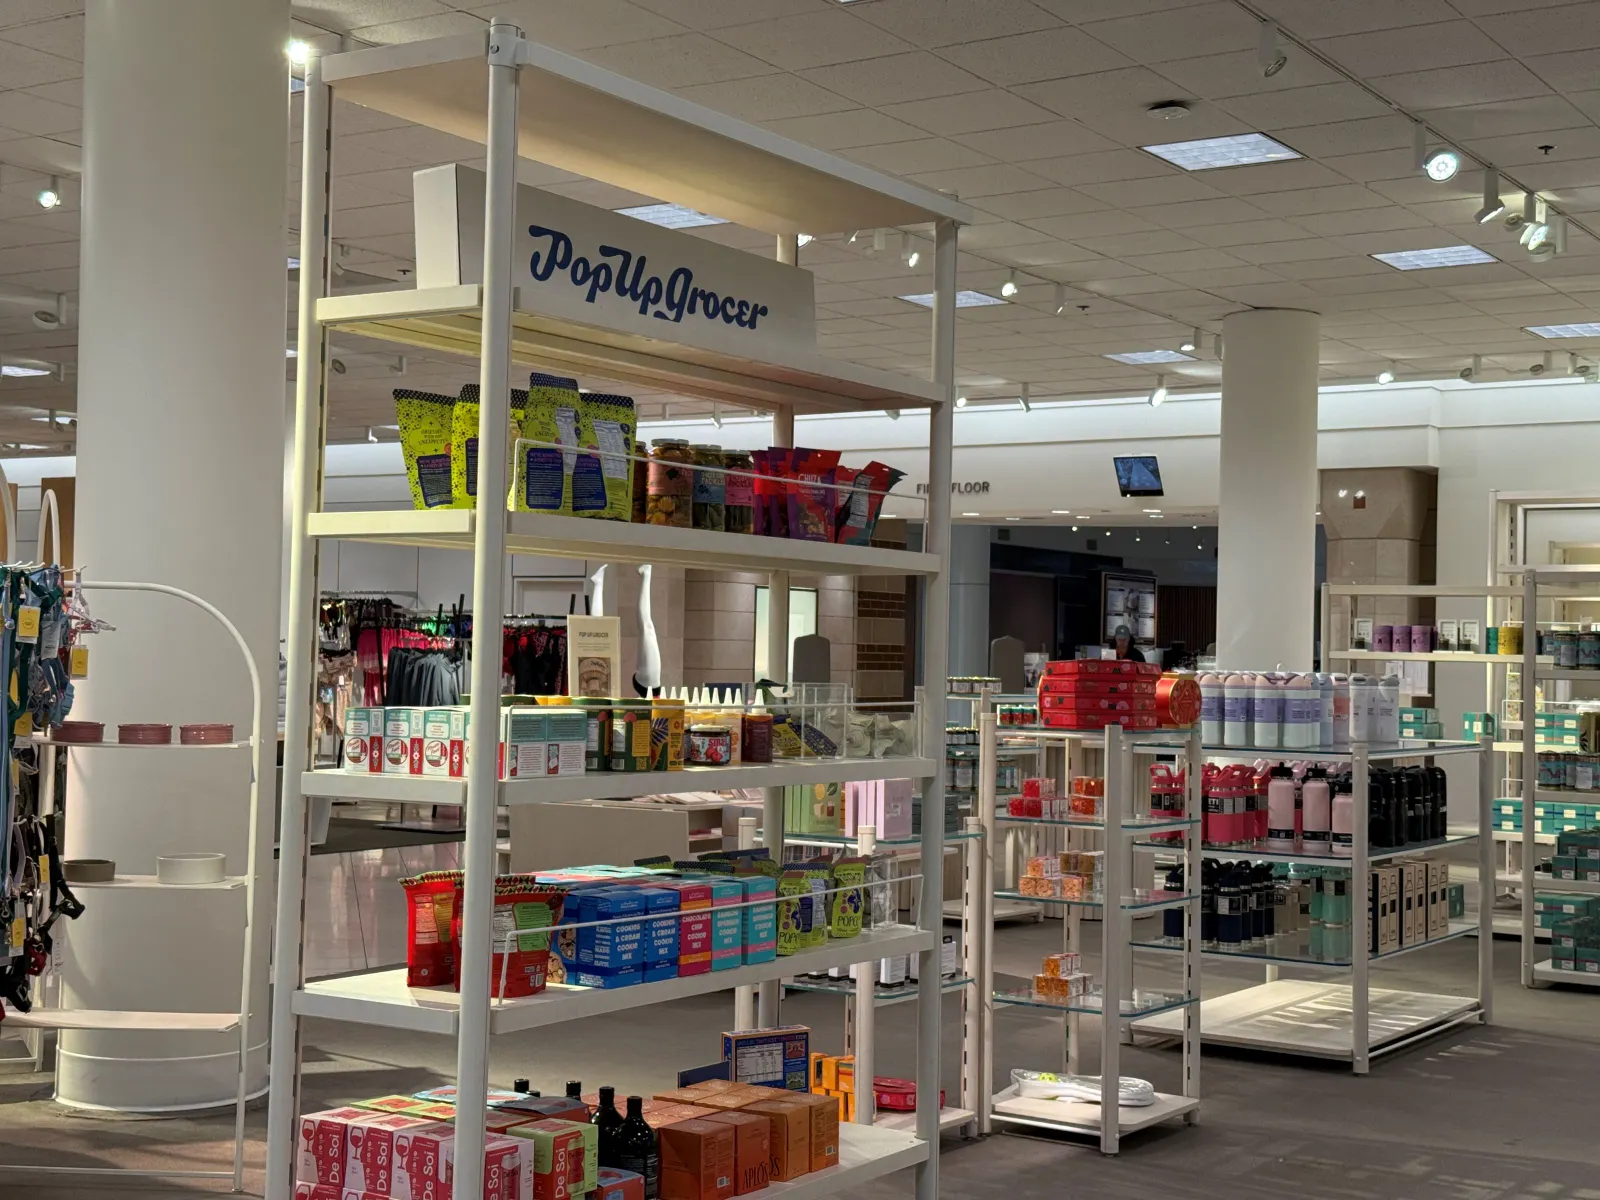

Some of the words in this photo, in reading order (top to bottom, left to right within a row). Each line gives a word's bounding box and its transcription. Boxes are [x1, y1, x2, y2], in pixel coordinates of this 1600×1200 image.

[951, 481, 990, 494] FLOOR
[652, 918, 676, 928] COOKIES
[682, 913, 711, 923] CHOCOLATE
[615, 923, 641, 934] COOKIES
[691, 923, 703, 931] CHIP
[754, 921, 773, 931] COOKIE
[656, 927, 676, 937] CREAM
[687, 931, 707, 941] COOKIE
[719, 927, 738, 937] COOKIE
[759, 930, 768, 939] MIX
[620, 933, 641, 942] CREAM
[653, 937, 674, 947] COOKIE
[723, 937, 733, 945] MIX
[616, 942, 639, 952] COOKIE
[692, 941, 702, 949] MIX
[658, 947, 669, 955] MIX
[621, 952, 633, 961] MIX
[328, 1133, 340, 1158] Soi
[377, 1141, 389, 1166] Soi
[423, 1150, 435, 1176] Soi
[555, 1147, 566, 1173] Soi
[329, 1161, 340, 1184] De
[487, 1164, 499, 1190] Soi
[376, 1169, 388, 1192] De
[422, 1181, 434, 1200] De
[555, 1175, 565, 1199] De
